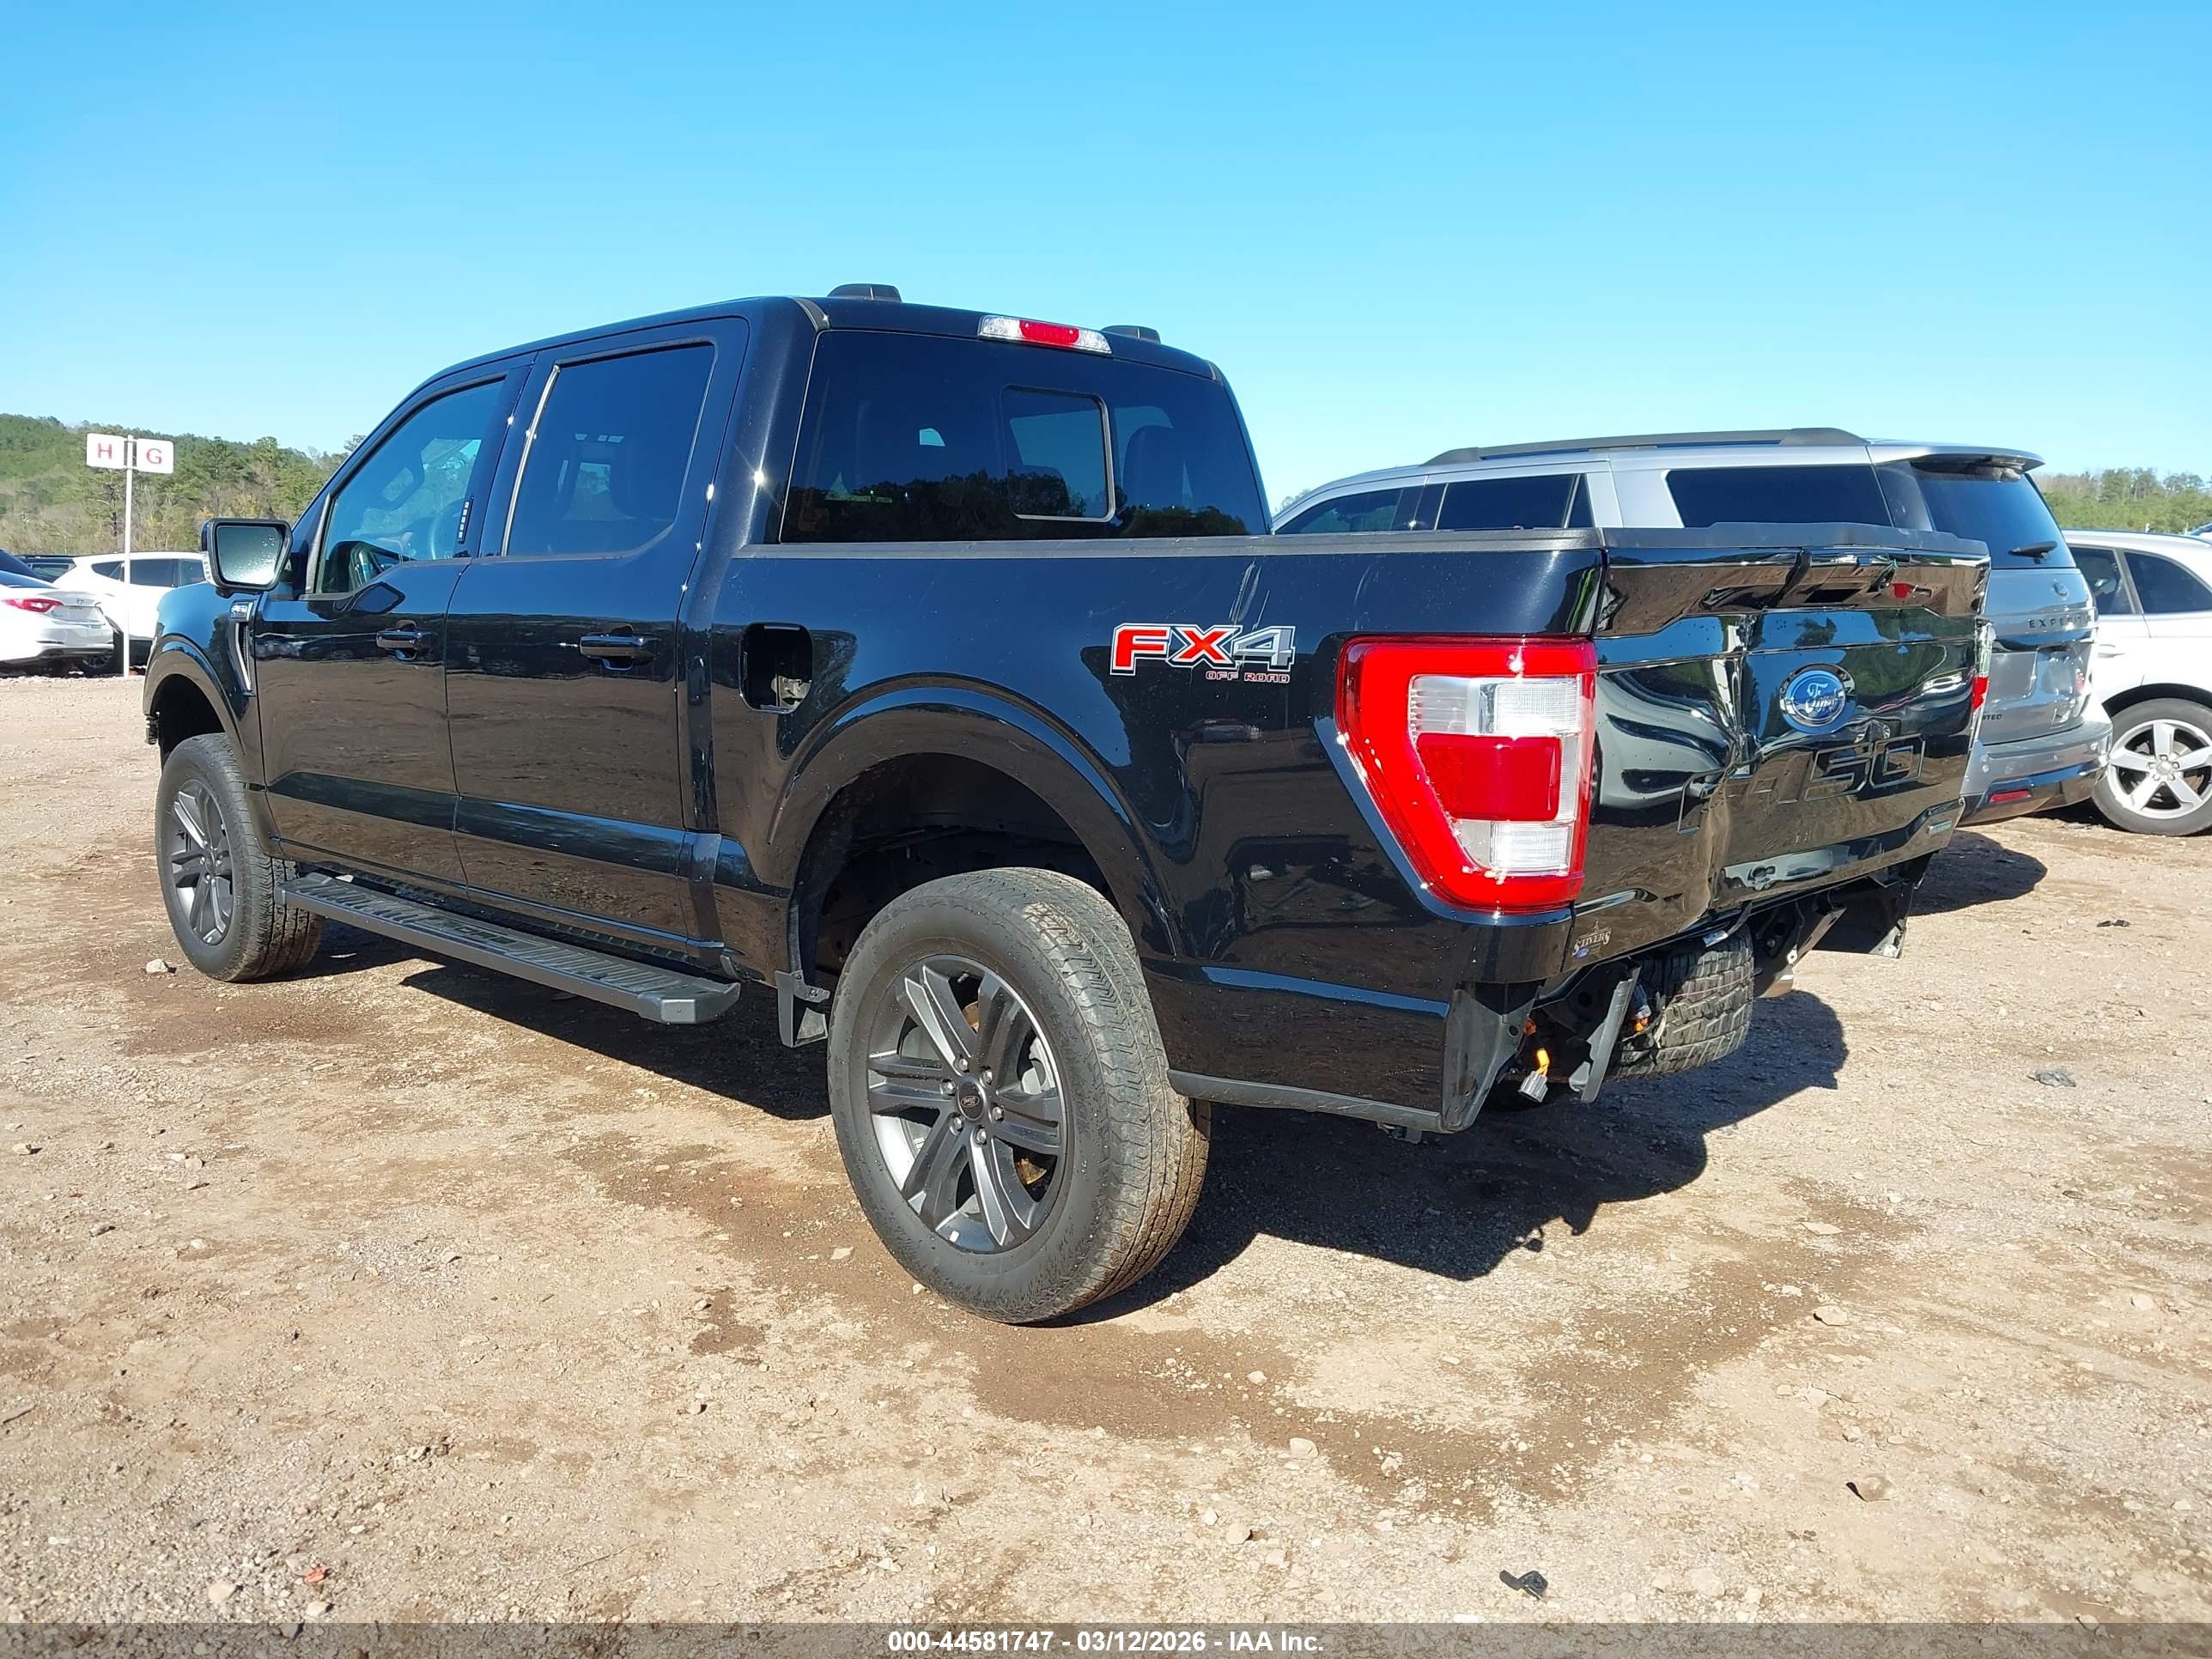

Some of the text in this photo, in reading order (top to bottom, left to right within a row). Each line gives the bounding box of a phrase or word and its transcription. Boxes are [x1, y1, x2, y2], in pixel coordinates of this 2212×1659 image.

[97, 442, 112, 459] H
[146, 447, 162, 465] G
[1109, 623, 1297, 676] FX4
[1205, 670, 1291, 684] OFF ROAD
[1806, 682, 1838, 714] Ford
[1571, 928, 1613, 956] STIVERS
